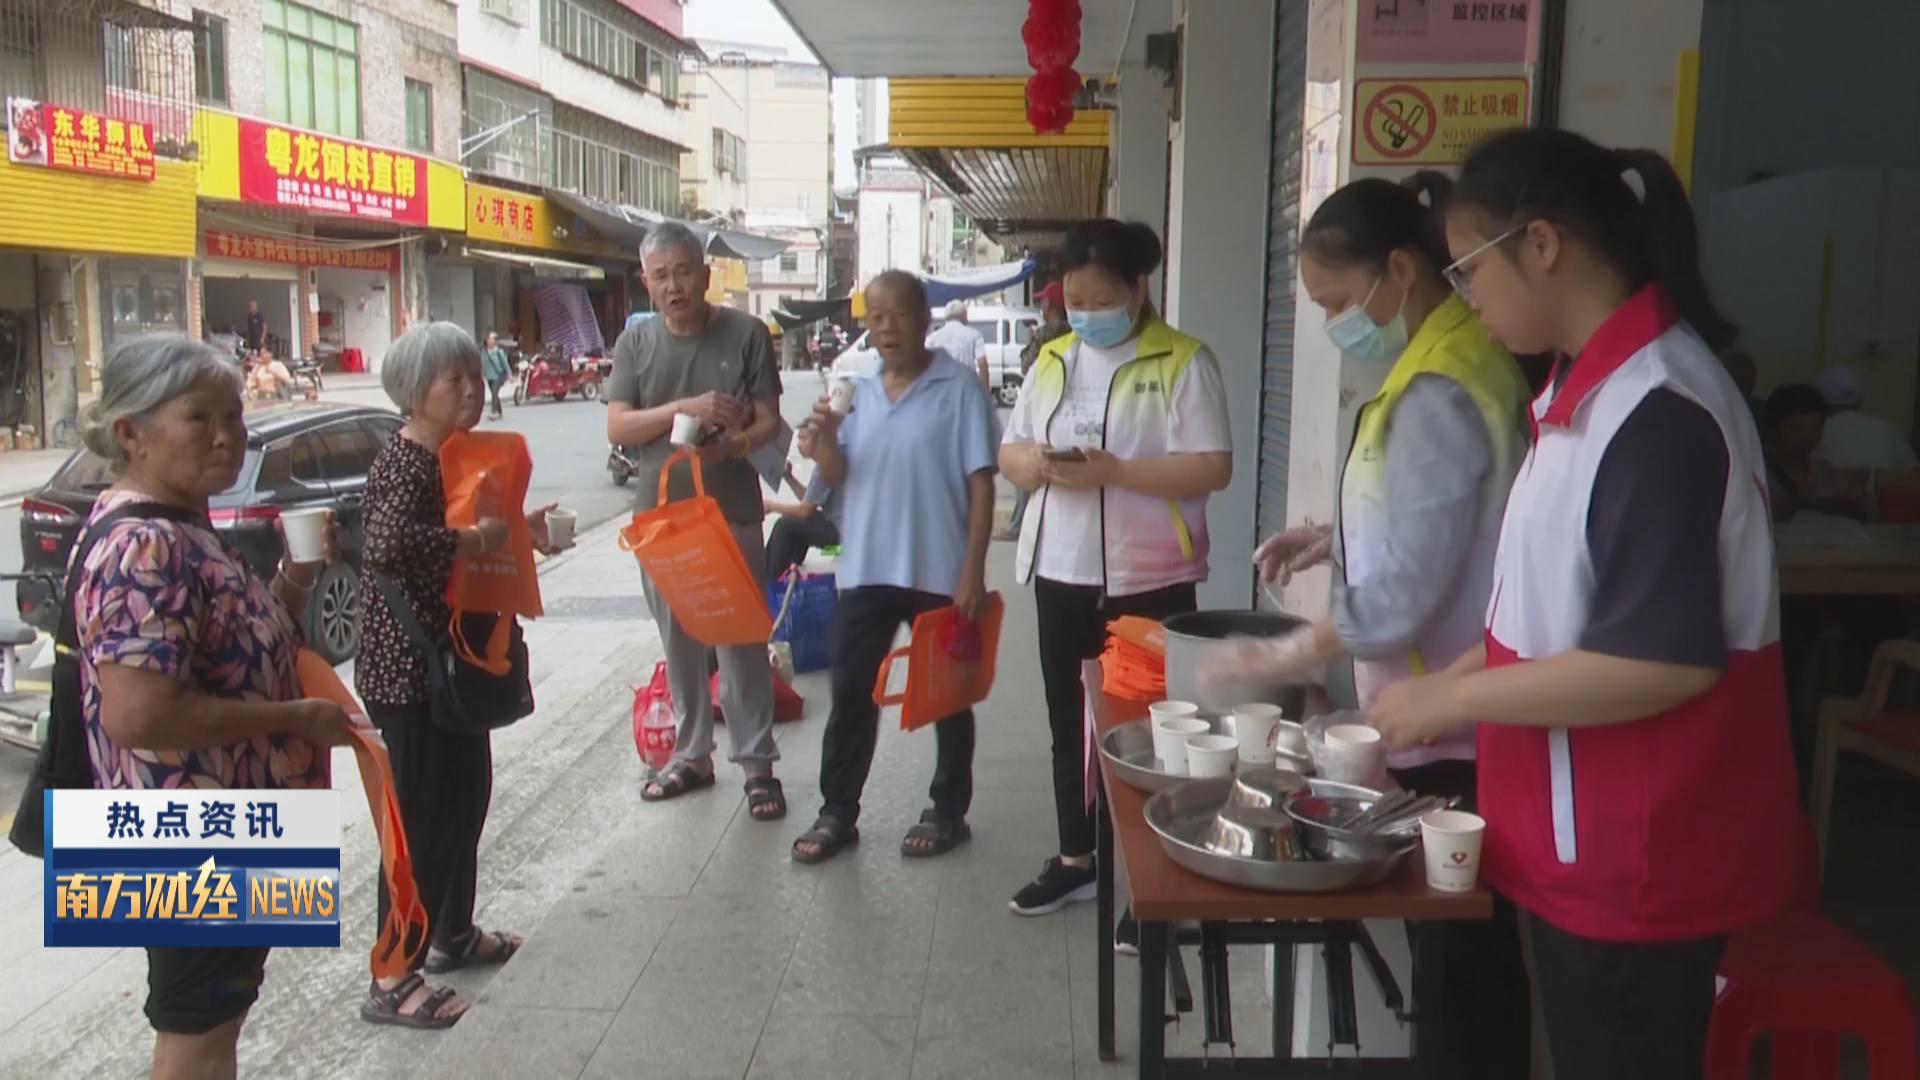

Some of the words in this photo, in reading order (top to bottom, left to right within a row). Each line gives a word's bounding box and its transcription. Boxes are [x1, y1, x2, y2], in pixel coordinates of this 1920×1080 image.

[1452, 3, 1528, 21] 监控区域
[1443, 93, 1519, 116] 禁止吸烟
[265, 127, 416, 198] 粤龙饲料直销
[476, 194, 533, 233] 心琪商店
